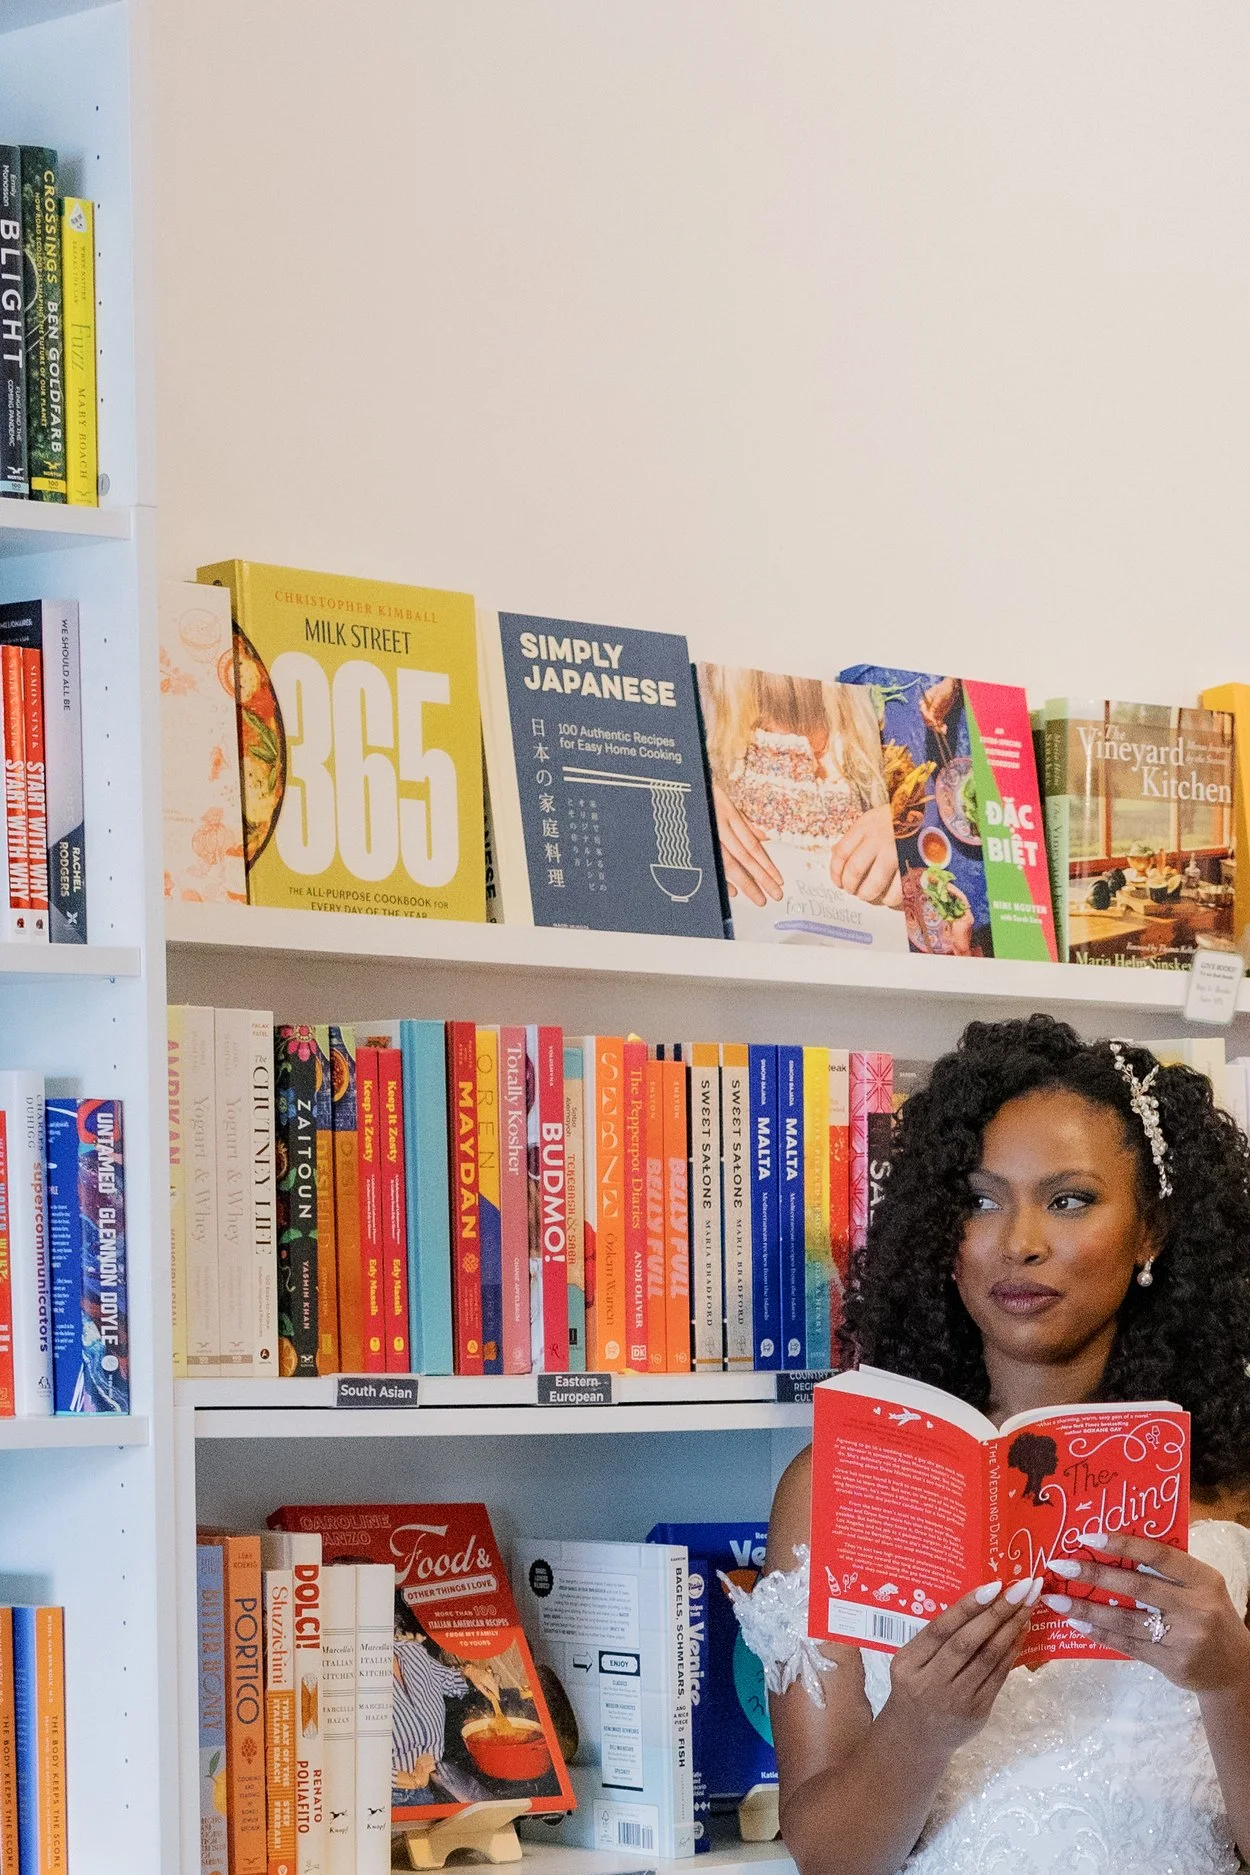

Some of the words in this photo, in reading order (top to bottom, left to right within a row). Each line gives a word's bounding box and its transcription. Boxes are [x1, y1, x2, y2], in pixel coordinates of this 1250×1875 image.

[43, 170, 57, 284] CROSSINGS
[0, 219, 22, 369] BLIGHT
[47, 301, 60, 340] BEN
[49, 347, 62, 452] GOLDFARB
[61, 619, 70, 636] WE
[274, 590, 372, 614] CHRISTOPHER
[379, 605, 438, 623] KIMBALL
[61, 636, 71, 677] SHOULD
[305, 617, 347, 646] MILK
[351, 624, 411, 655] STREET
[520, 632, 623, 669] SIMPLY
[62, 678, 71, 697] ALL
[63, 698, 72, 711] BE
[523, 665, 676, 708] JAPANESE
[558, 722, 579, 736] 100
[580, 723, 632, 743] Authentic
[633, 732, 676, 749] Recipes
[1076, 726, 1185, 772] Vineyard
[27, 761, 46, 815] START
[270, 651, 459, 888] 365
[1141, 766, 1232, 803] Kitchen
[531, 717, 566, 888] 日本の家庭料理
[29, 816, 48, 860] WITH
[30, 862, 49, 901] WHY
[60, 841, 72, 898] RODGERS
[72, 846, 82, 893] RACHEL
[630, 1068, 644, 1094] The
[25, 1096, 36, 1149] DUHIGG
[252, 1067, 272, 1190] CHUTNEY
[508, 1118, 523, 1176] Kosher
[627, 1100, 644, 1172] Pepperpot
[97, 1112, 117, 1195] UNTAMED
[298, 1100, 314, 1220] ZAITOUN
[757, 1116, 771, 1181] MALTA
[786, 1117, 799, 1181] MALTA
[543, 1122, 566, 1264] BUDMO!
[631, 1178, 644, 1229] Diaries
[99, 1207, 118, 1288] GLENNON
[254, 1201, 273, 1255] LIFE
[31, 1162, 51, 1353] supercommunicators
[634, 1251, 643, 1283] ANDI
[99, 1291, 119, 1346] DOYLE
[634, 1285, 644, 1328] OLIVER
[340, 1383, 379, 1398] South
[379, 1382, 413, 1399] Asian
[548, 1390, 605, 1404] European
[989, 1443, 998, 1465] THE
[989, 1465, 999, 1522] WEDDING
[989, 1523, 999, 1555] DATE
[1007, 1472, 1181, 1580] Wedding
[389, 1523, 476, 1586] Food
[474, 1547, 493, 1570] &
[295, 1564, 320, 1650] DOLCI!
[406, 1588, 435, 1601] OTHER
[435, 1584, 466, 1596] THINGS
[471, 1580, 493, 1592] LOVE
[674, 1568, 684, 1621] BAGELS,
[271, 1585, 289, 1685] Stuzzichini
[474, 1629, 499, 1637] FAMILY
[235, 1598, 260, 1725] PORTICO
[609, 1659, 630, 1667] ENJOY
[675, 1624, 686, 1700] SCHMEARS,
[52, 1715, 61, 1736] THE
[52, 1739, 61, 1769] BODY
[678, 1737, 687, 1768] FISH
[52, 1772, 61, 1805] KEEPS
[298, 1760, 310, 1834] POLIAFITO
[313, 1769, 323, 1824] RENATO
[53, 1809, 62, 1830] THE
[52, 1832, 62, 1869] SCORE
